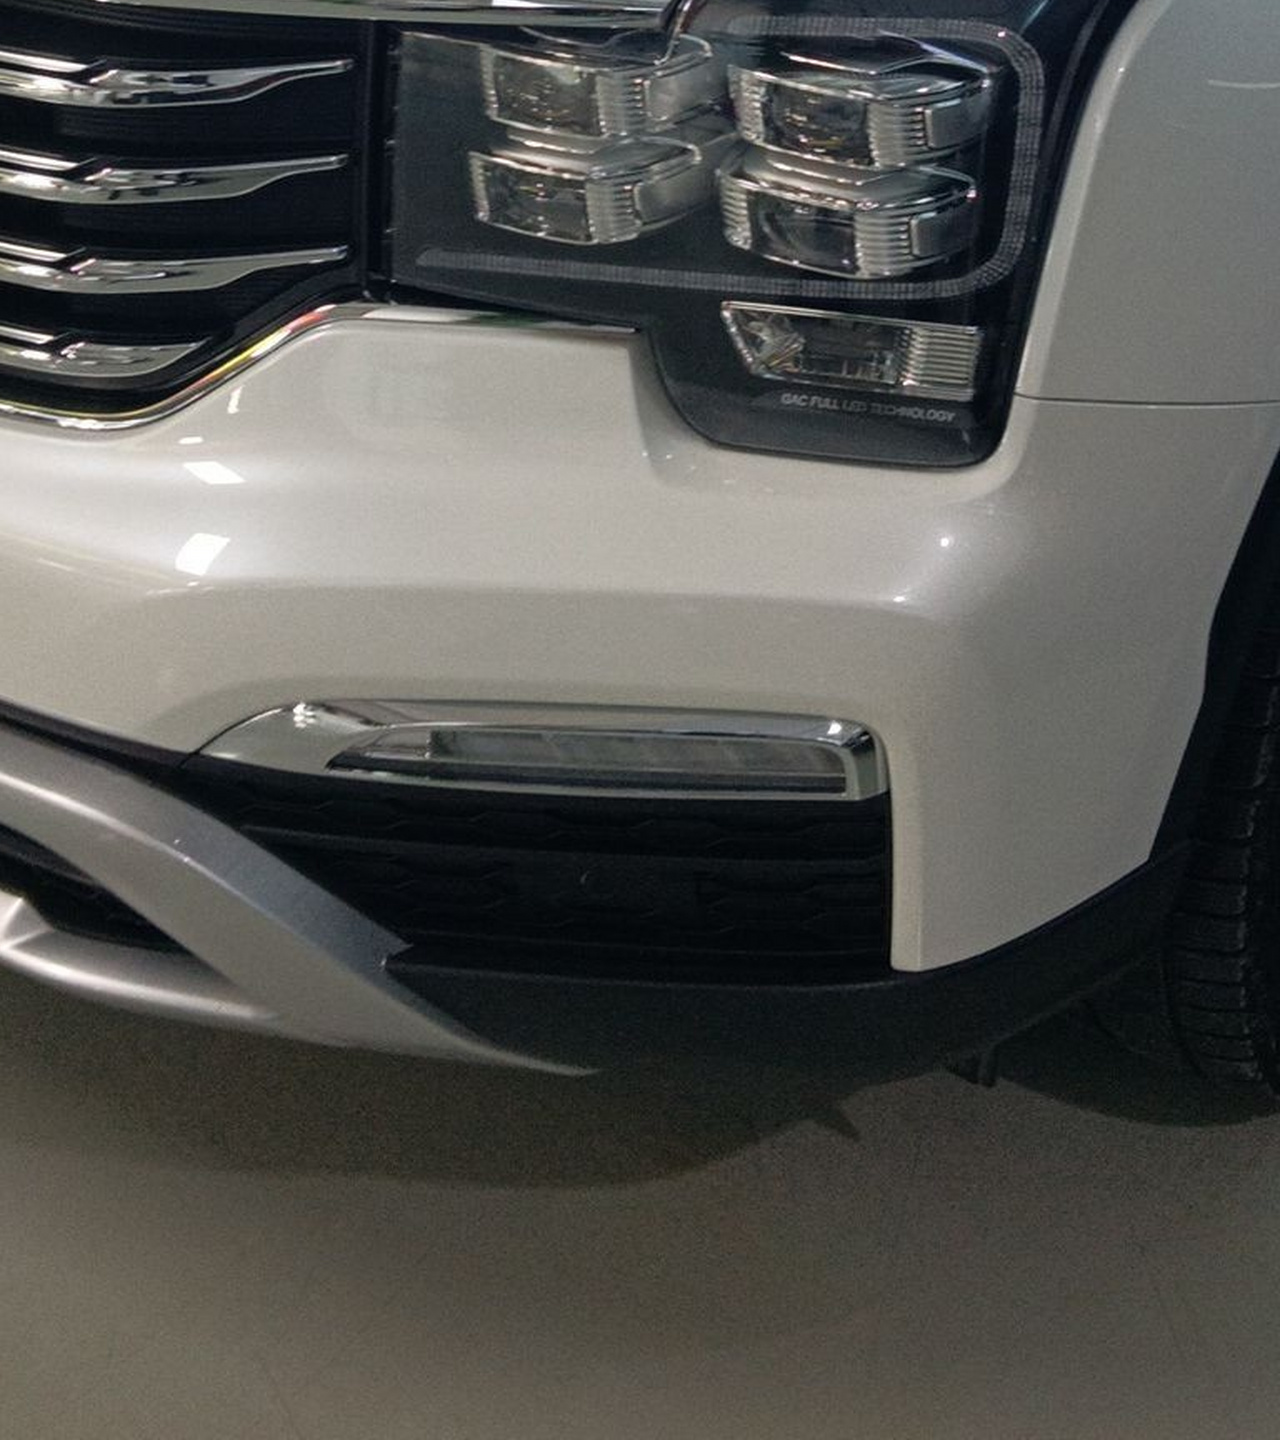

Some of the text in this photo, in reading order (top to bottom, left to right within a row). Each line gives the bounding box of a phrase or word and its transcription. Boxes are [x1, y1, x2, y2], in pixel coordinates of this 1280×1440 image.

[780, 392, 957, 423] GAC FULL LED TECHNOLOGY
